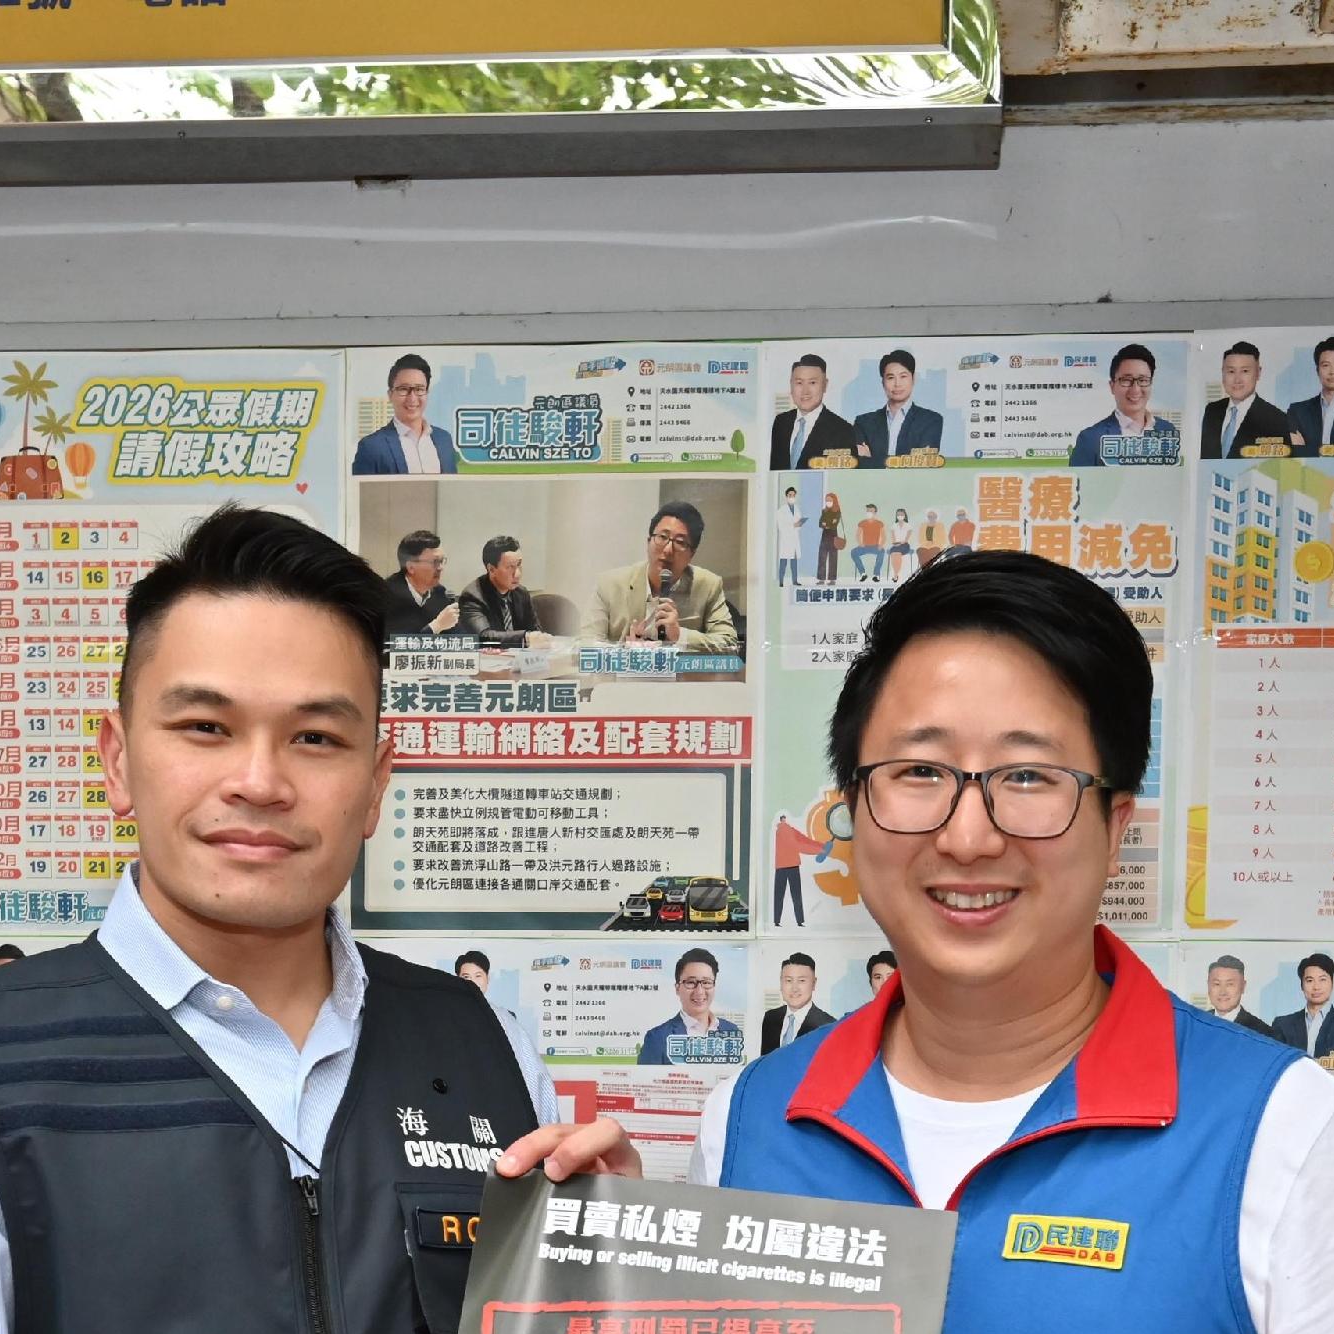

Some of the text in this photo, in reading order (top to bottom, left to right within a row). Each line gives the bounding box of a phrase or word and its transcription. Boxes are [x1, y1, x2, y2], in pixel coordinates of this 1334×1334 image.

[77, 385, 318, 427] 2026公眾假期
[458, 410, 600, 447] 司徒駿軒
[114, 432, 300, 478] 請假攻略
[489, 447, 592, 460] CALVIN SZE TO
[978, 476, 1076, 521] 醫療
[61, 532, 69, 543] 2
[90, 532, 99, 543] 3
[119, 532, 129, 543] 4
[27, 571, 132, 583] 14 15 16 17
[1123, 586, 1163, 600] 受助人
[394, 655, 475, 670] 廖振新副局長
[579, 648, 678, 673] 司徒駿軒
[544, 1198, 887, 1267] 買賣私煙 均屬違法
[1048, 1224, 1119, 1251] 民建聯
[539, 1243, 882, 1294] Buying or selling illicit cigarettes is illegal
[1078, 1250, 1116, 1262] DAB
